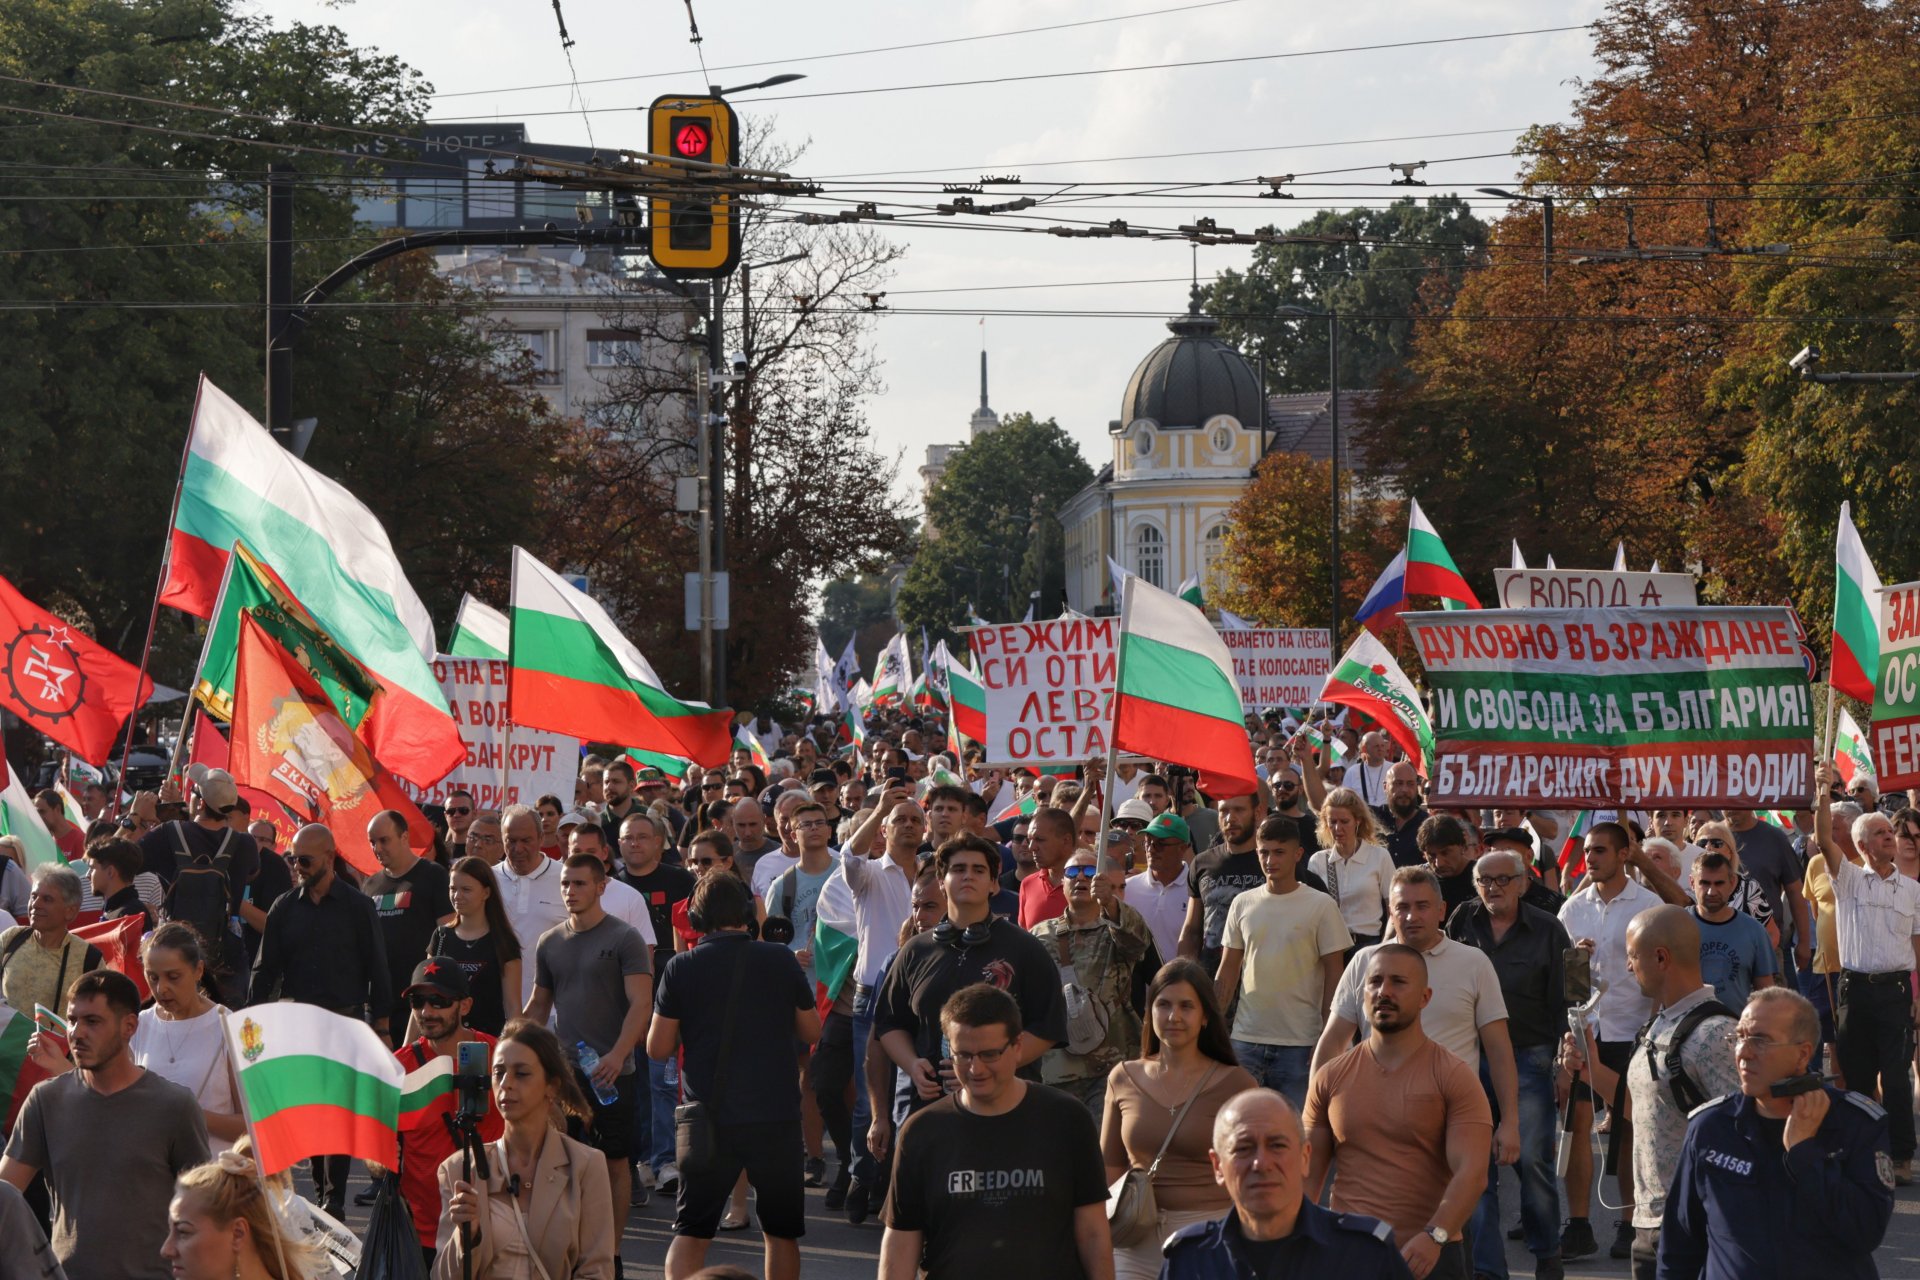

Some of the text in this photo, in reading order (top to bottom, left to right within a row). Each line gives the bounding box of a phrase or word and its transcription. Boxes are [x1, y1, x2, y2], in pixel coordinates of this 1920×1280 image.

[426, 135, 504, 153] HOTE
[1503, 572, 1663, 607] СВОБОДА
[976, 618, 1121, 654] РЕЖИМ
[1219, 631, 1275, 648] АВАНЕТО
[1279, 631, 1294, 648] НА
[1417, 619, 1795, 666] ДУХОВНО ВЪЗРАЖДАНЕ
[455, 660, 484, 685] НА
[983, 652, 1117, 689] СИ ОТИ
[1259, 658, 1329, 676] КОЛОСАЛЕН
[1884, 652, 1920, 706] ОС
[1260, 685, 1311, 707] НАРОДА!
[1437, 684, 1809, 739] И СВОБОДА ЗА БЪЛГАРИЯ!
[465, 741, 555, 772] БАНКРУТ
[1007, 725, 1107, 759] ОСТА
[1437, 754, 1612, 799] БЪЛГАРСКИЯТ
[1618, 756, 1674, 803] ДУХ
[1682, 754, 1718, 798] НИ
[1726, 752, 1807, 803] ВОДИ!
[258, 808, 296, 834] НАР
[1700, 941, 1729, 954] OPER
[1705, 1147, 1753, 1177] 241563
[948, 1168, 1045, 1194] FREEDOM
